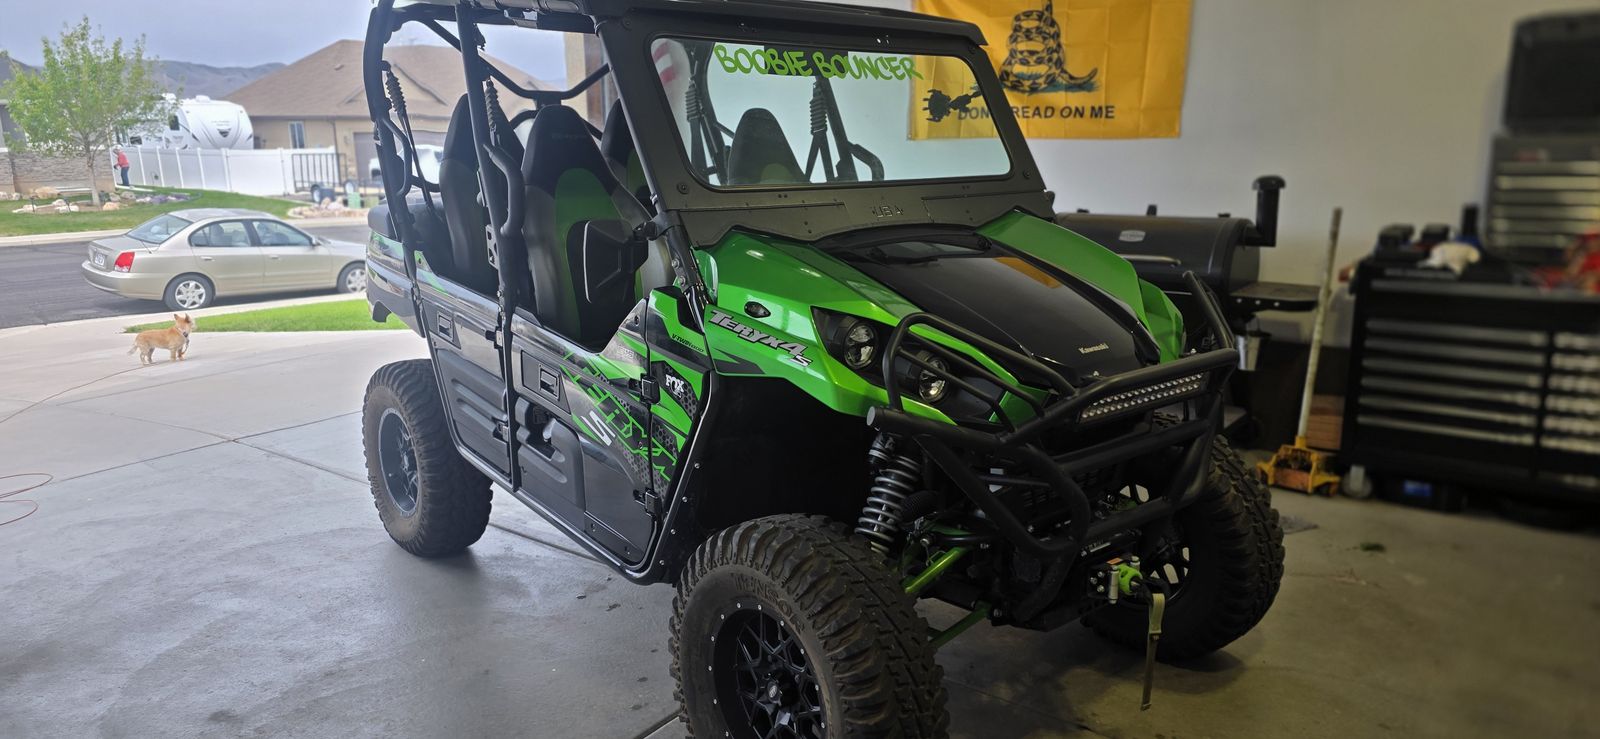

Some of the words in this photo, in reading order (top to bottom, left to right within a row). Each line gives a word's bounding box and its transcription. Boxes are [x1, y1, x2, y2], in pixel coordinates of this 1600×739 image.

[713, 44, 814, 77] BOOBIE
[812, 51, 924, 81] BOUNCER
[957, 106, 992, 120] DON
[1012, 105, 1055, 119] READ
[1059, 106, 1086, 119] ON
[1089, 105, 1116, 119] ME
[665, 374, 685, 396] FOX
